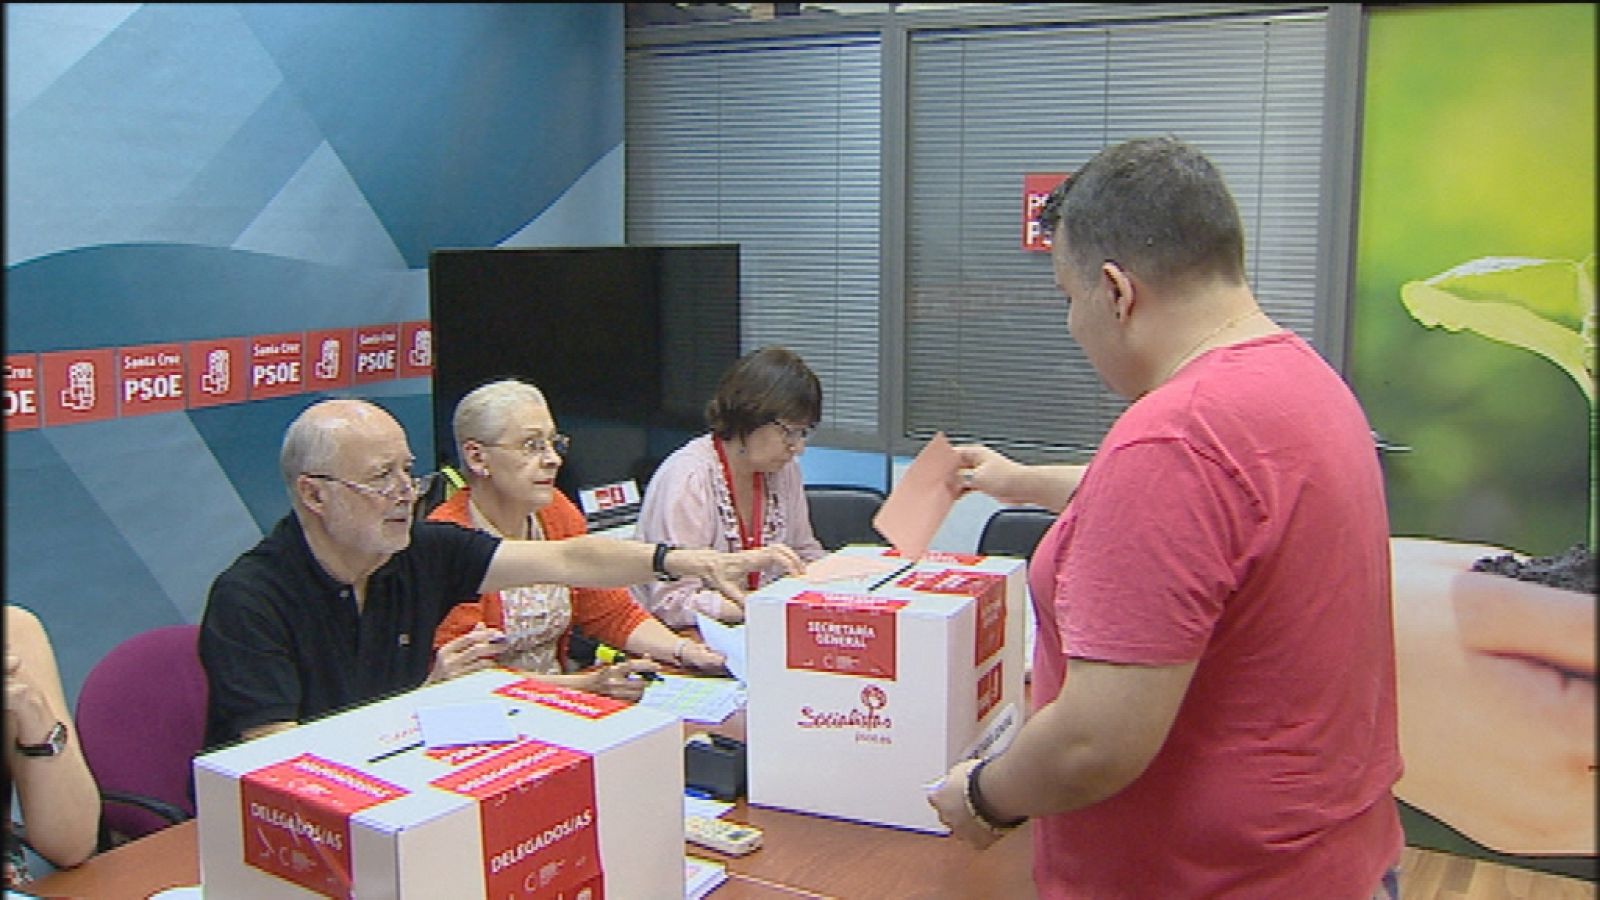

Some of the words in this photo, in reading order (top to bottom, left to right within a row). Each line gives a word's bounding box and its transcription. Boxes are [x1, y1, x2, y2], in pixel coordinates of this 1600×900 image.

[124, 355, 156, 369] Santa
[157, 352, 181, 366] Cruz
[253, 344, 278, 356] Santa
[281, 343, 301, 353] Cruz
[357, 350, 397, 372] PSOE
[253, 362, 301, 387] PSOE
[124, 375, 183, 402] PSOE
[815, 634, 867, 648] GENERAL
[251, 802, 343, 851] DELEGADOS/AS
[490, 809, 592, 874] DELEGADOS/AS
